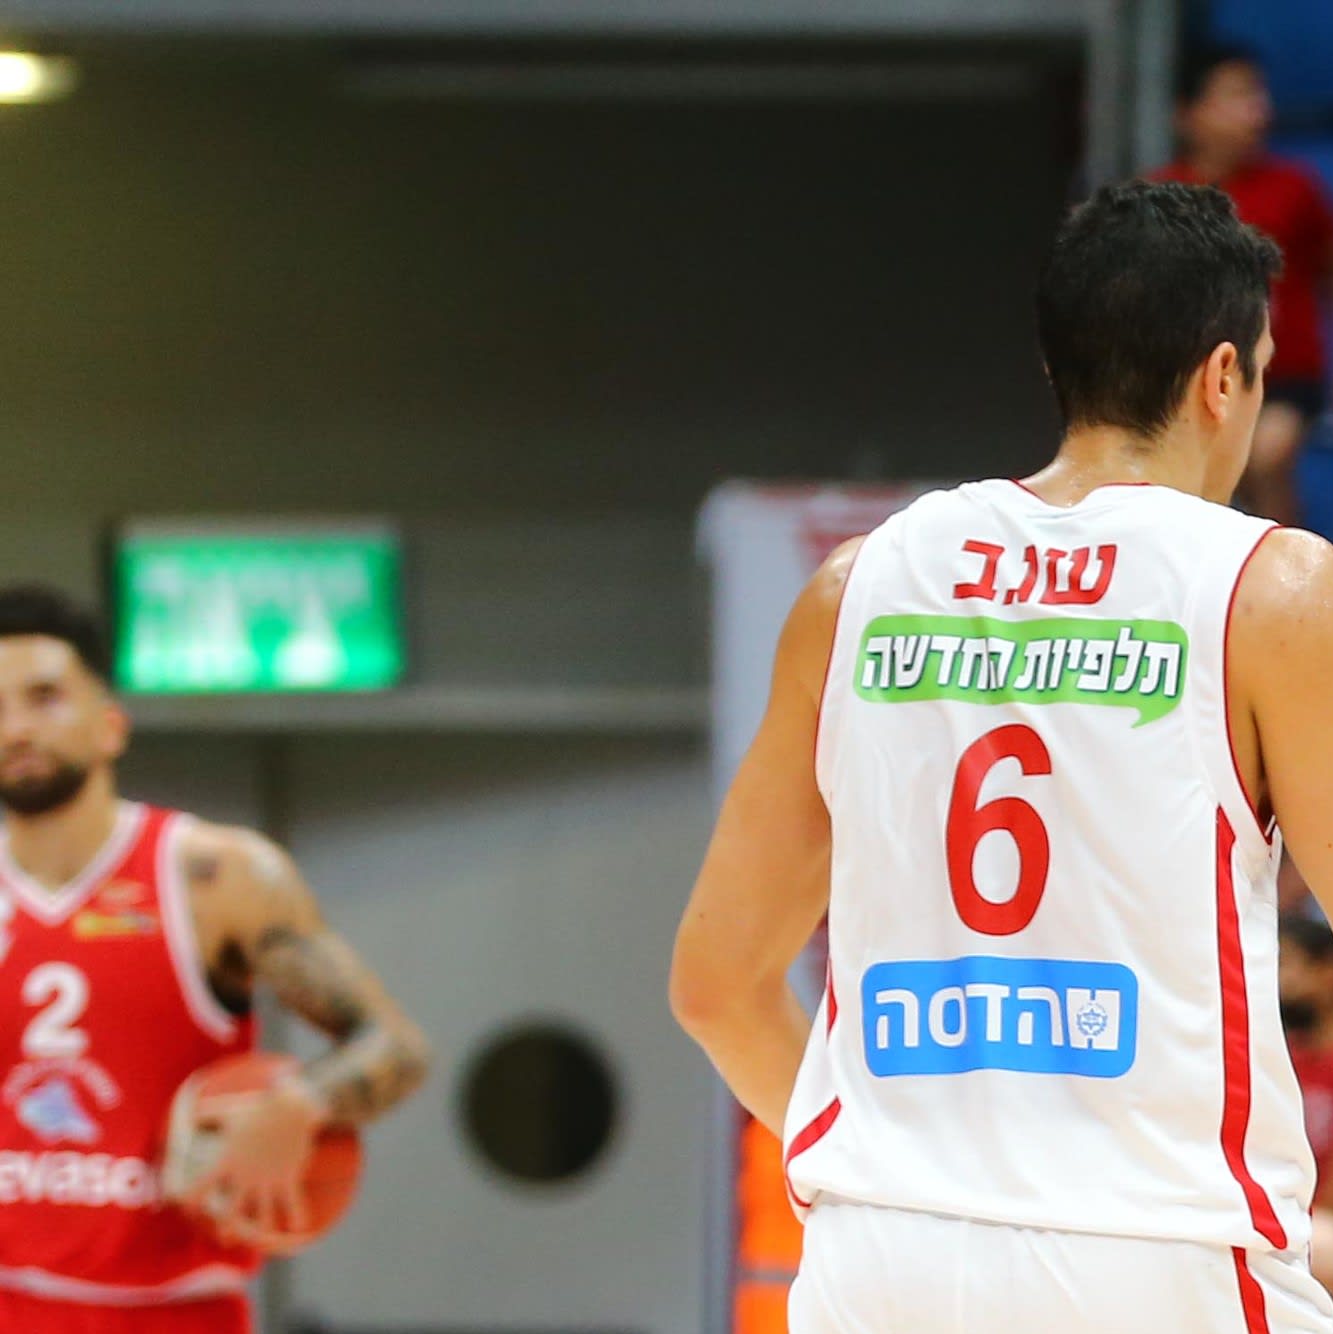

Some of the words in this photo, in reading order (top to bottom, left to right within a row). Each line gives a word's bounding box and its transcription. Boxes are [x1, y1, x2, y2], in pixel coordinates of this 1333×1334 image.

[952, 539, 1118, 605] שגב
[1014, 627, 1181, 697] תלפיות
[945, 723, 1052, 937] 6
[20, 960, 90, 1058] 2
